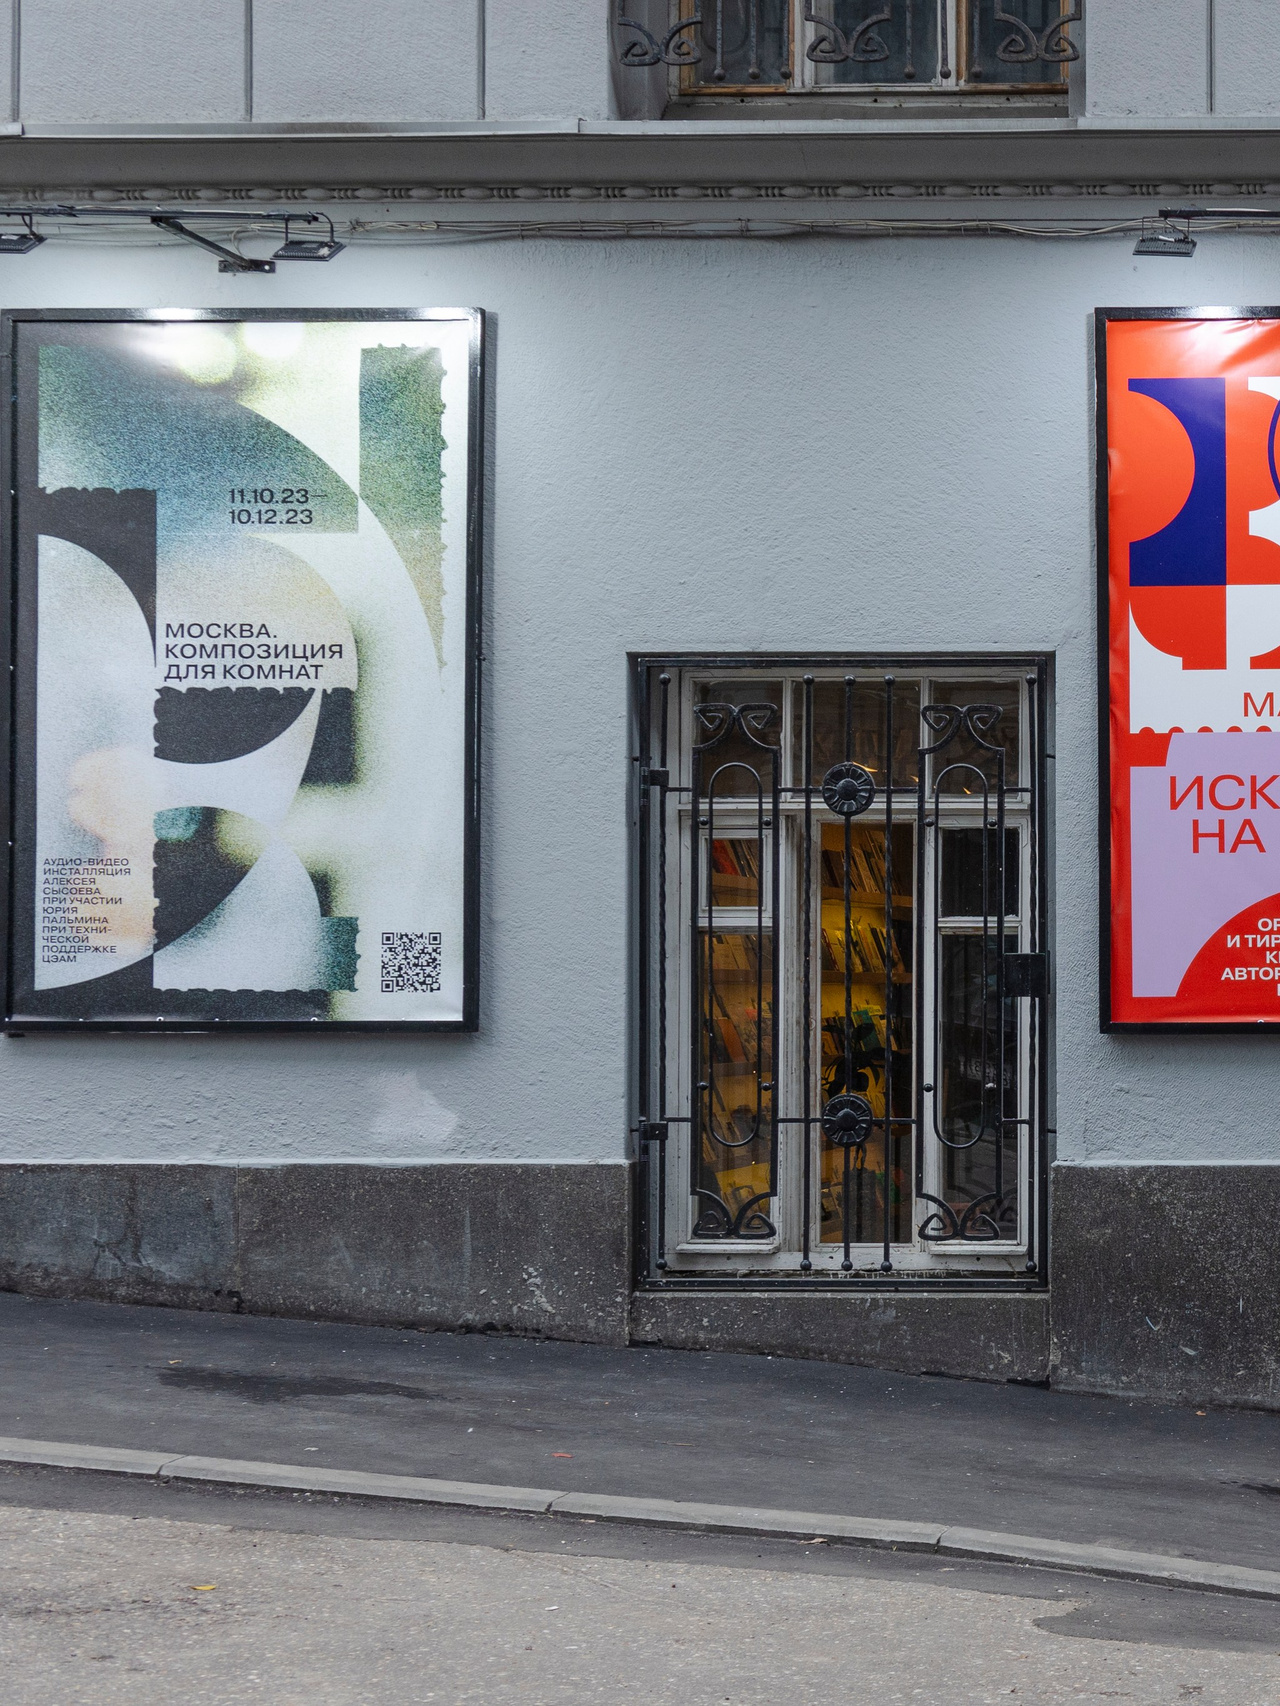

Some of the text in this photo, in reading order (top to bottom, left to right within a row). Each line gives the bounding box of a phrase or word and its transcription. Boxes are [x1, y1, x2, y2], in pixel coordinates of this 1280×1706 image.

[228, 509, 313, 525] 10.12.23
[165, 623, 277, 639] МОСКВА.
[165, 644, 343, 661] КОМПОЗИЦИЯ
[164, 664, 324, 682] ДЛЯ КОМНАТ
[1192, 818, 1266, 854] НА
[43, 858, 129, 867] АУДИО-ВИДЕО
[43, 868, 131, 877] ИНСТАЛЛЯЦИЯ
[43, 887, 101, 895] СЫСОЕВА
[43, 897, 122, 905] ПРИ УЧАСТИИ
[42, 926, 112, 934] ПРИ ТЕХНИ-
[42, 934, 89, 943] ЧЕСКОЙ
[1227, 934, 1240, 948] И
[42, 945, 117, 954] ПОДДЕРЖКЕ
[42, 955, 77, 963] ЦЭАМ
